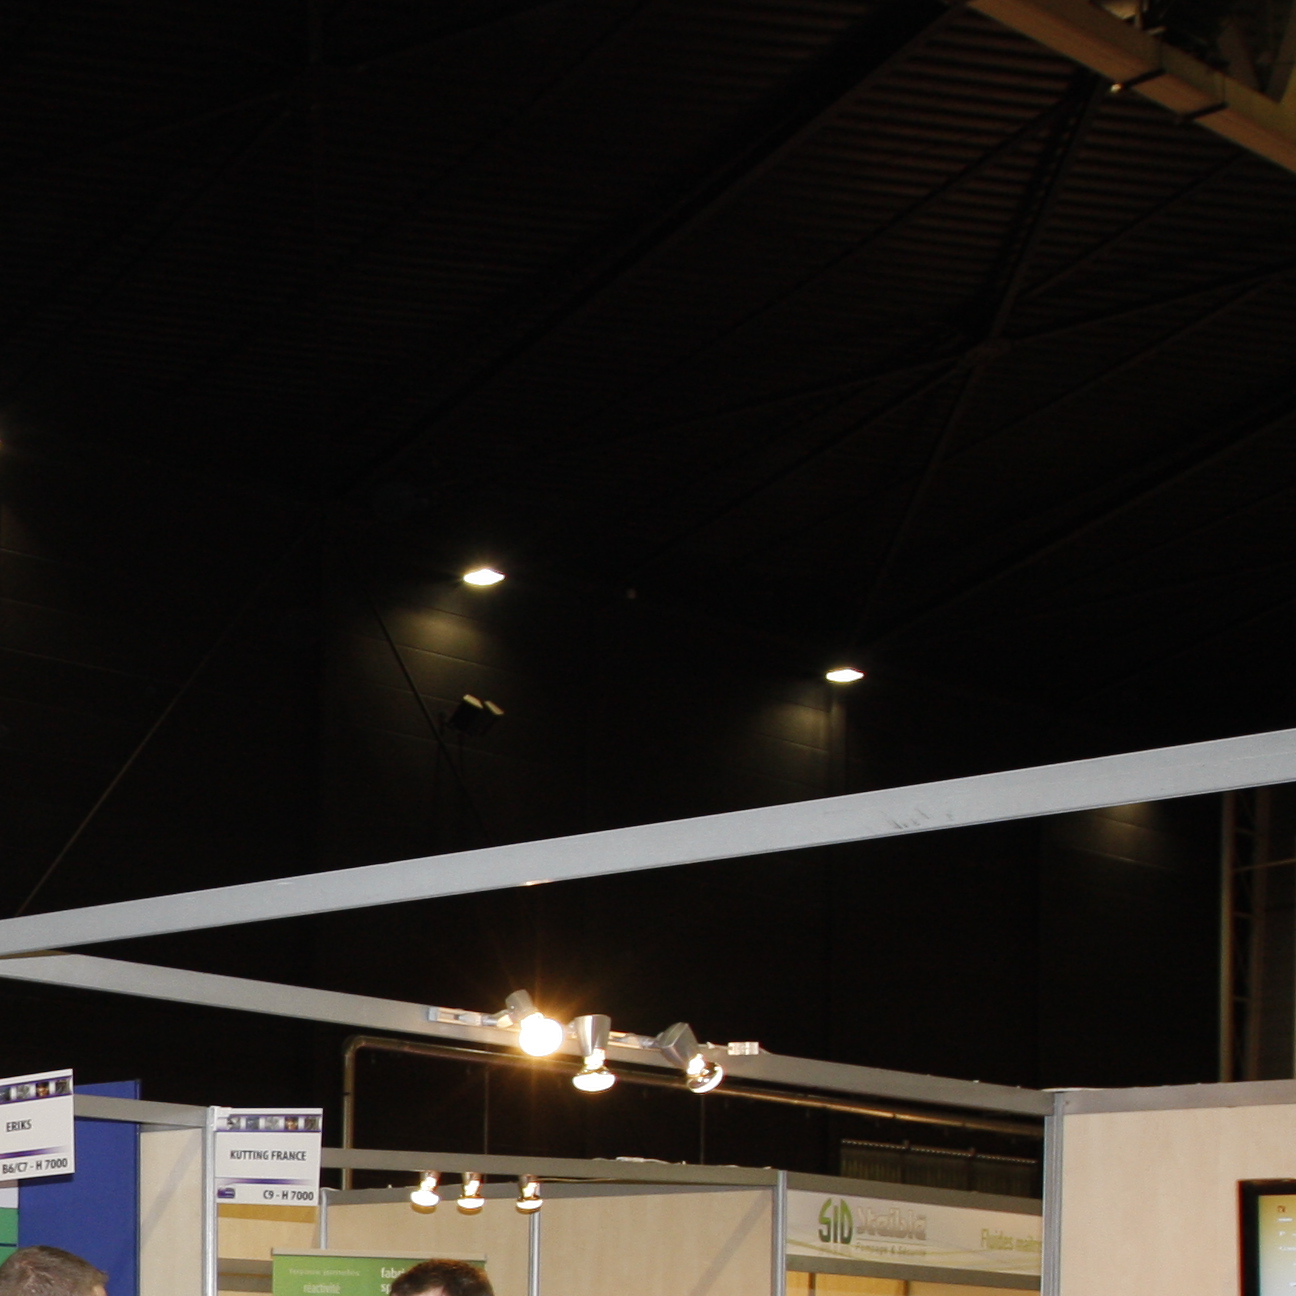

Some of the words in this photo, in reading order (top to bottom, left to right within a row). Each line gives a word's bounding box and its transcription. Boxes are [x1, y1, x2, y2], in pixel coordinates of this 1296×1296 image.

[6, 1119, 32, 1132] ERIKS
[230, 1150, 269, 1160] KUTTING
[271, 1150, 306, 1161] FRANCE
[2, 1162, 28, 1174] B6/C7
[36, 1161, 42, 1170] H
[45, 1158, 68, 1169] 7000
[263, 1190, 274, 1199] C9
[282, 1191, 288, 1199] H
[291, 1191, 314, 1200] 7000
[818, 1198, 853, 1244] SID
